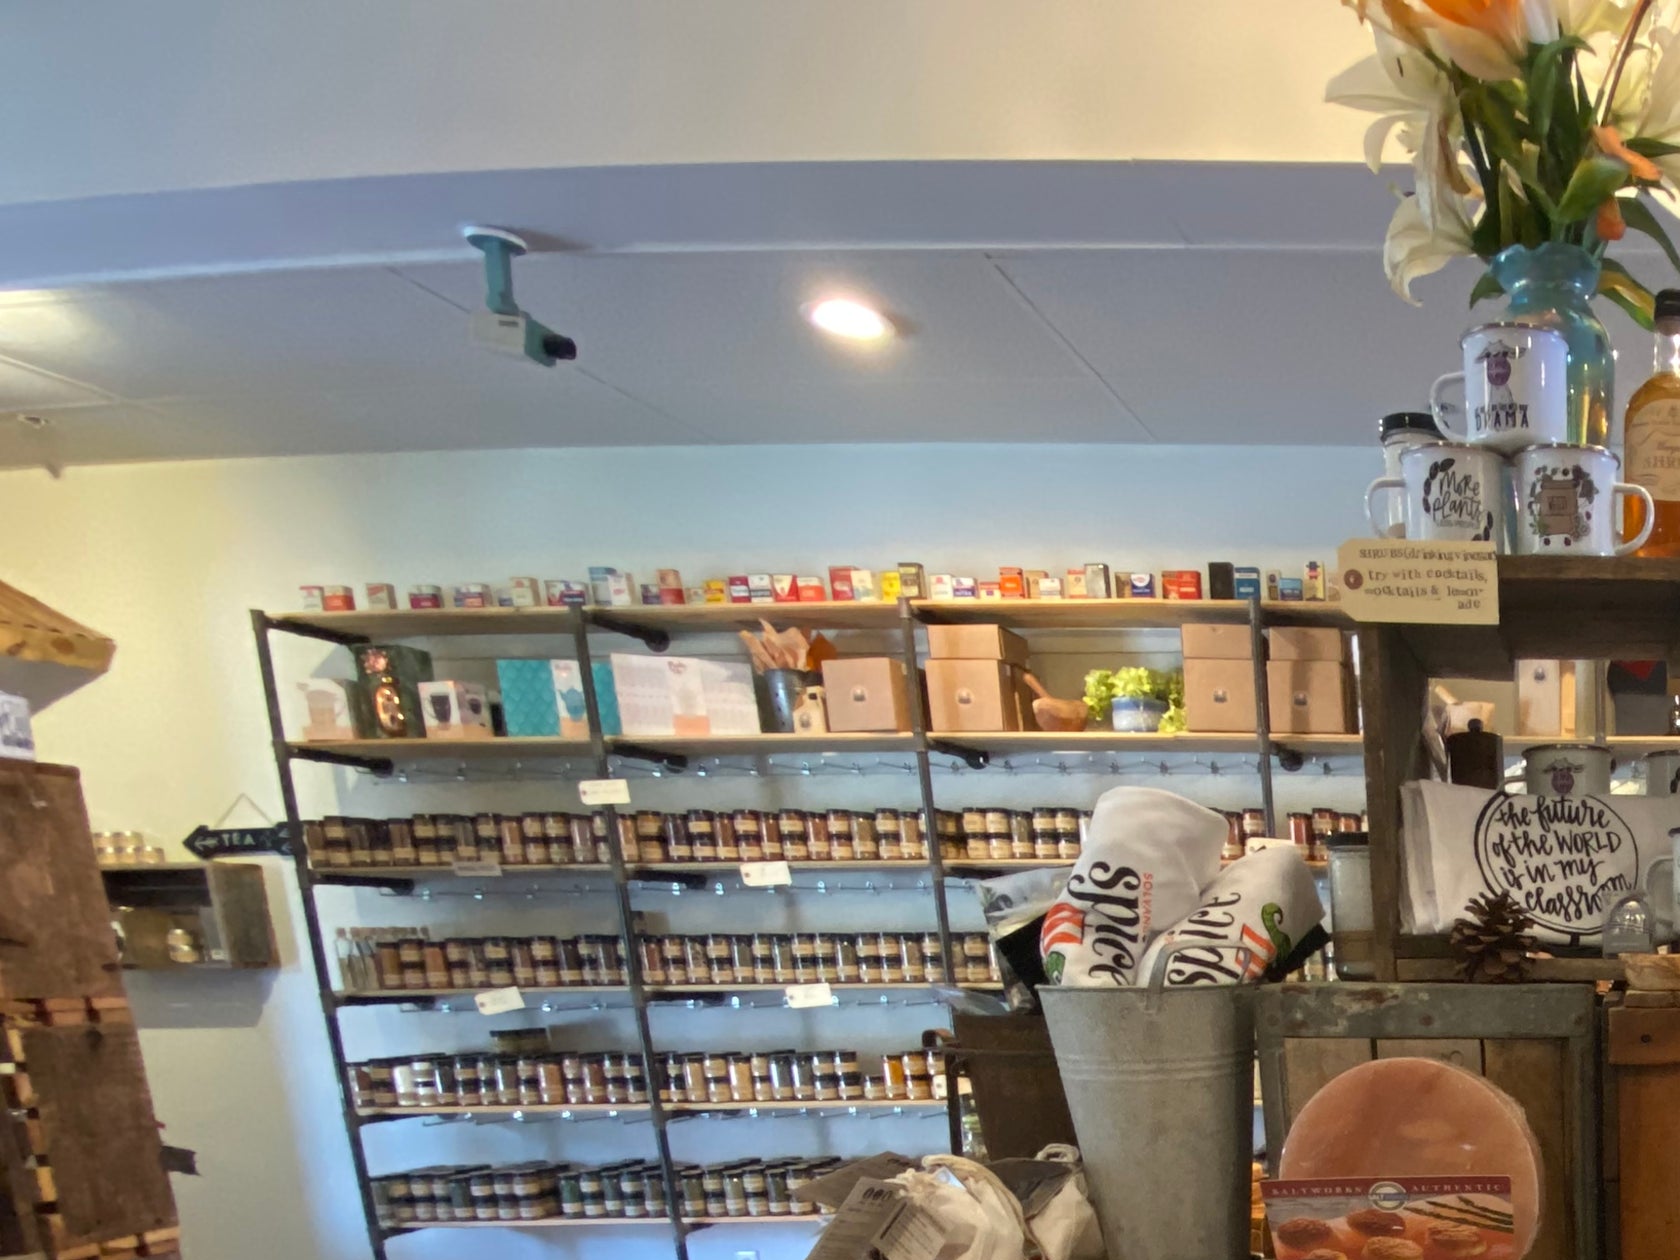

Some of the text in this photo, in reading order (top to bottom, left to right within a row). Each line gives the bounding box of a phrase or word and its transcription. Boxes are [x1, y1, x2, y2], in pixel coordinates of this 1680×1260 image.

[1496, 795, 1610, 833] the future
[221, 832, 256, 847] TEA
[1492, 830, 1622, 868] of the WORLD
[1500, 856, 1606, 890] is in my
[1141, 872, 1153, 933] SOLVAN
[1272, 1183, 1501, 1196] SALTWORKS AUTHENTIC
